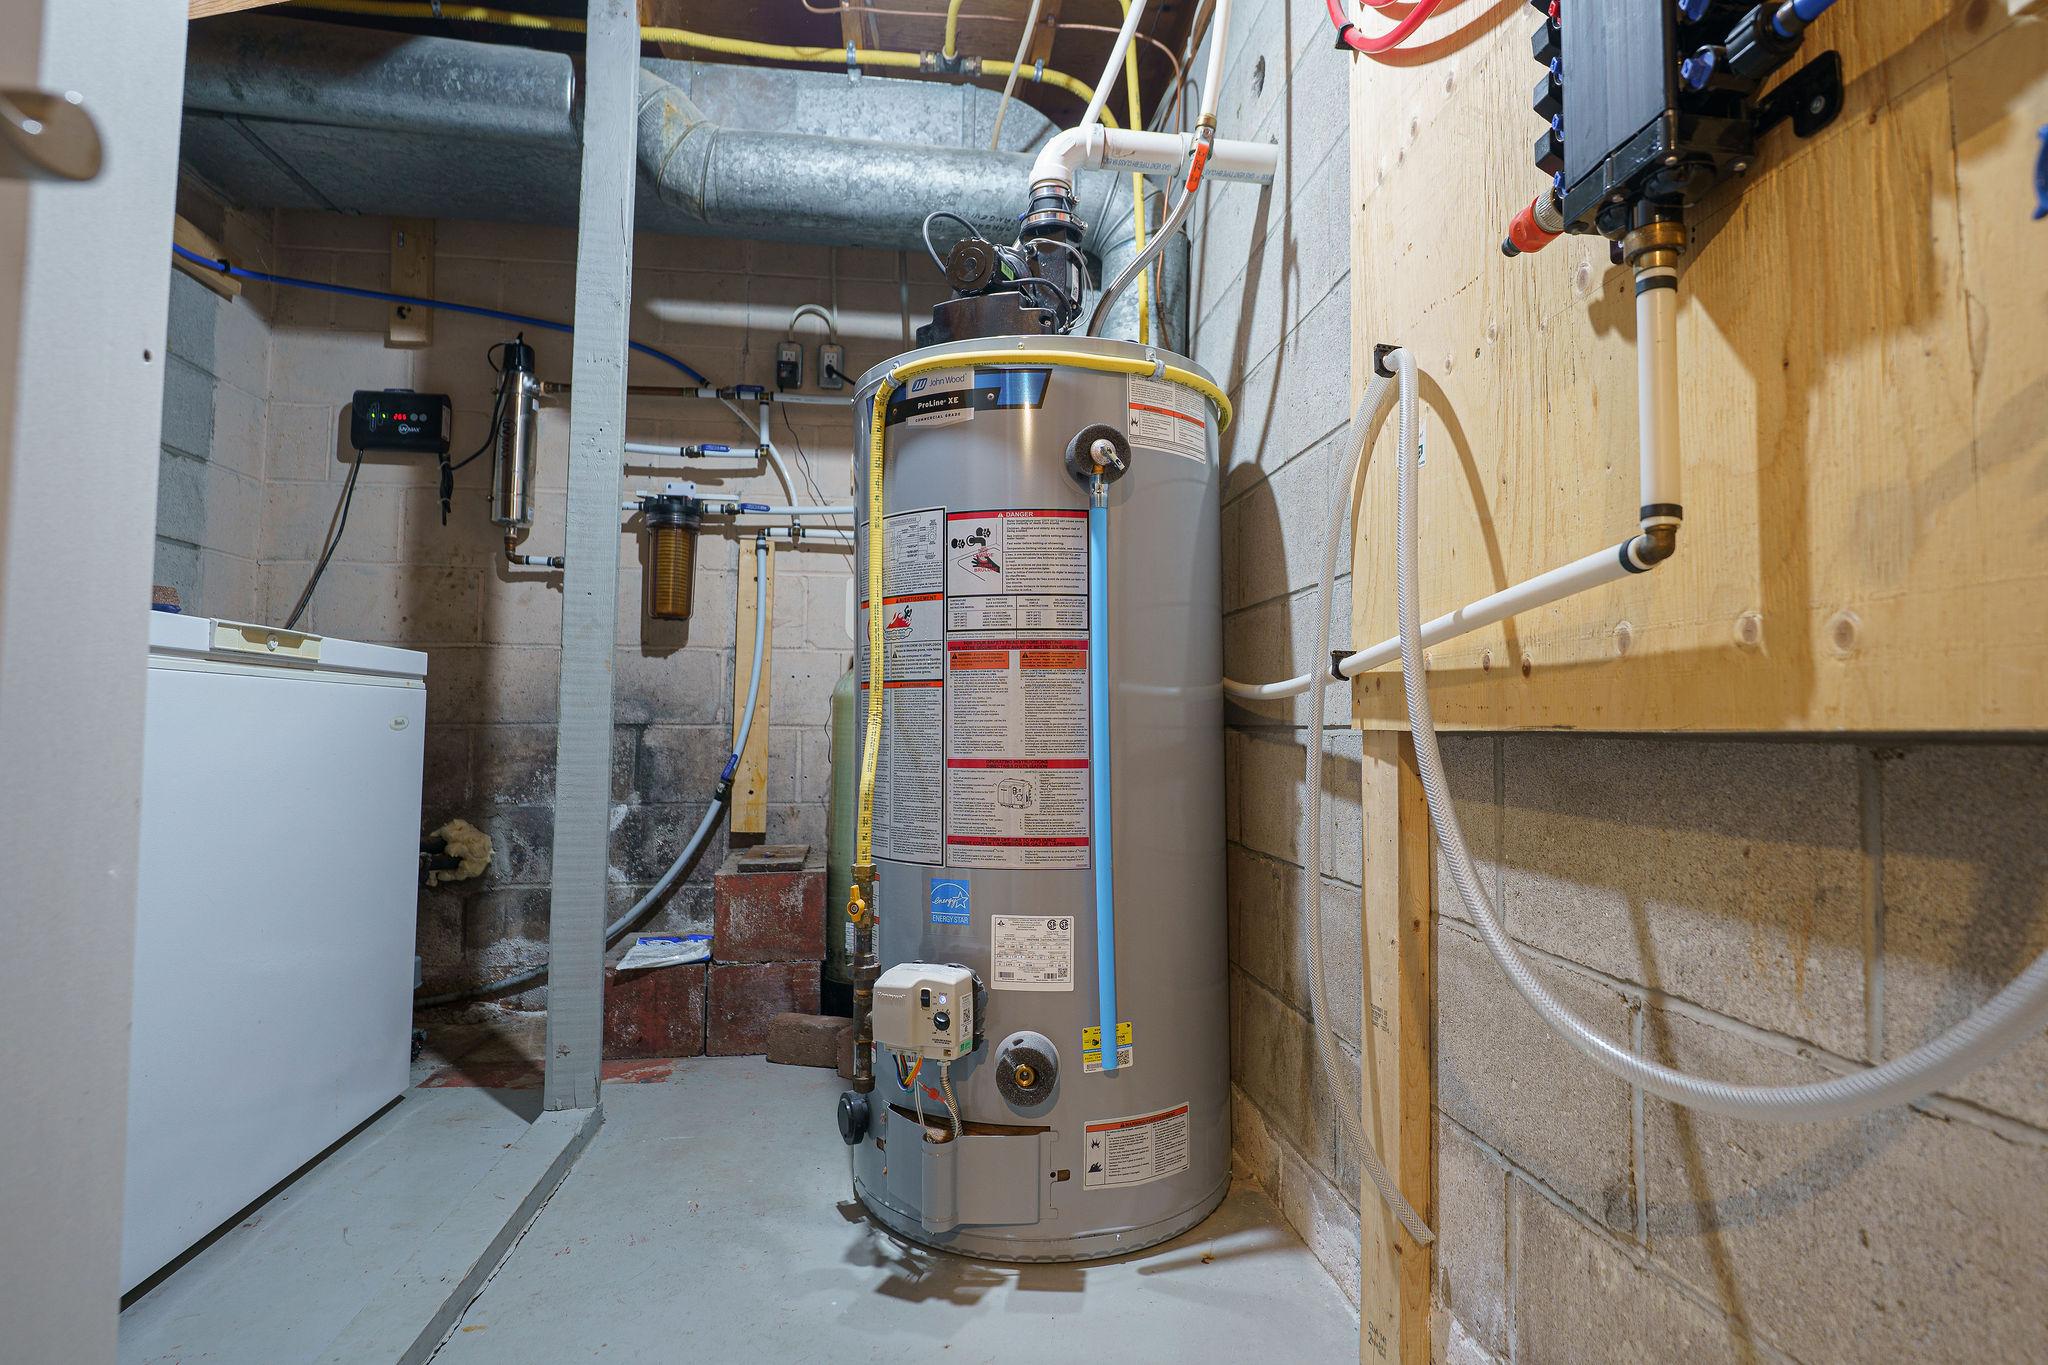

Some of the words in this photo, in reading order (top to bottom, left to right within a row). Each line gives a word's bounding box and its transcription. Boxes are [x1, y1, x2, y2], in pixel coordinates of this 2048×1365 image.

[929, 378, 944, 386] John
[945, 374, 964, 384] Wood
[948, 396, 959, 404] XE
[932, 896, 956, 908] energy
[933, 914, 953, 922] ENERGY
[954, 916, 968, 924] STAR
